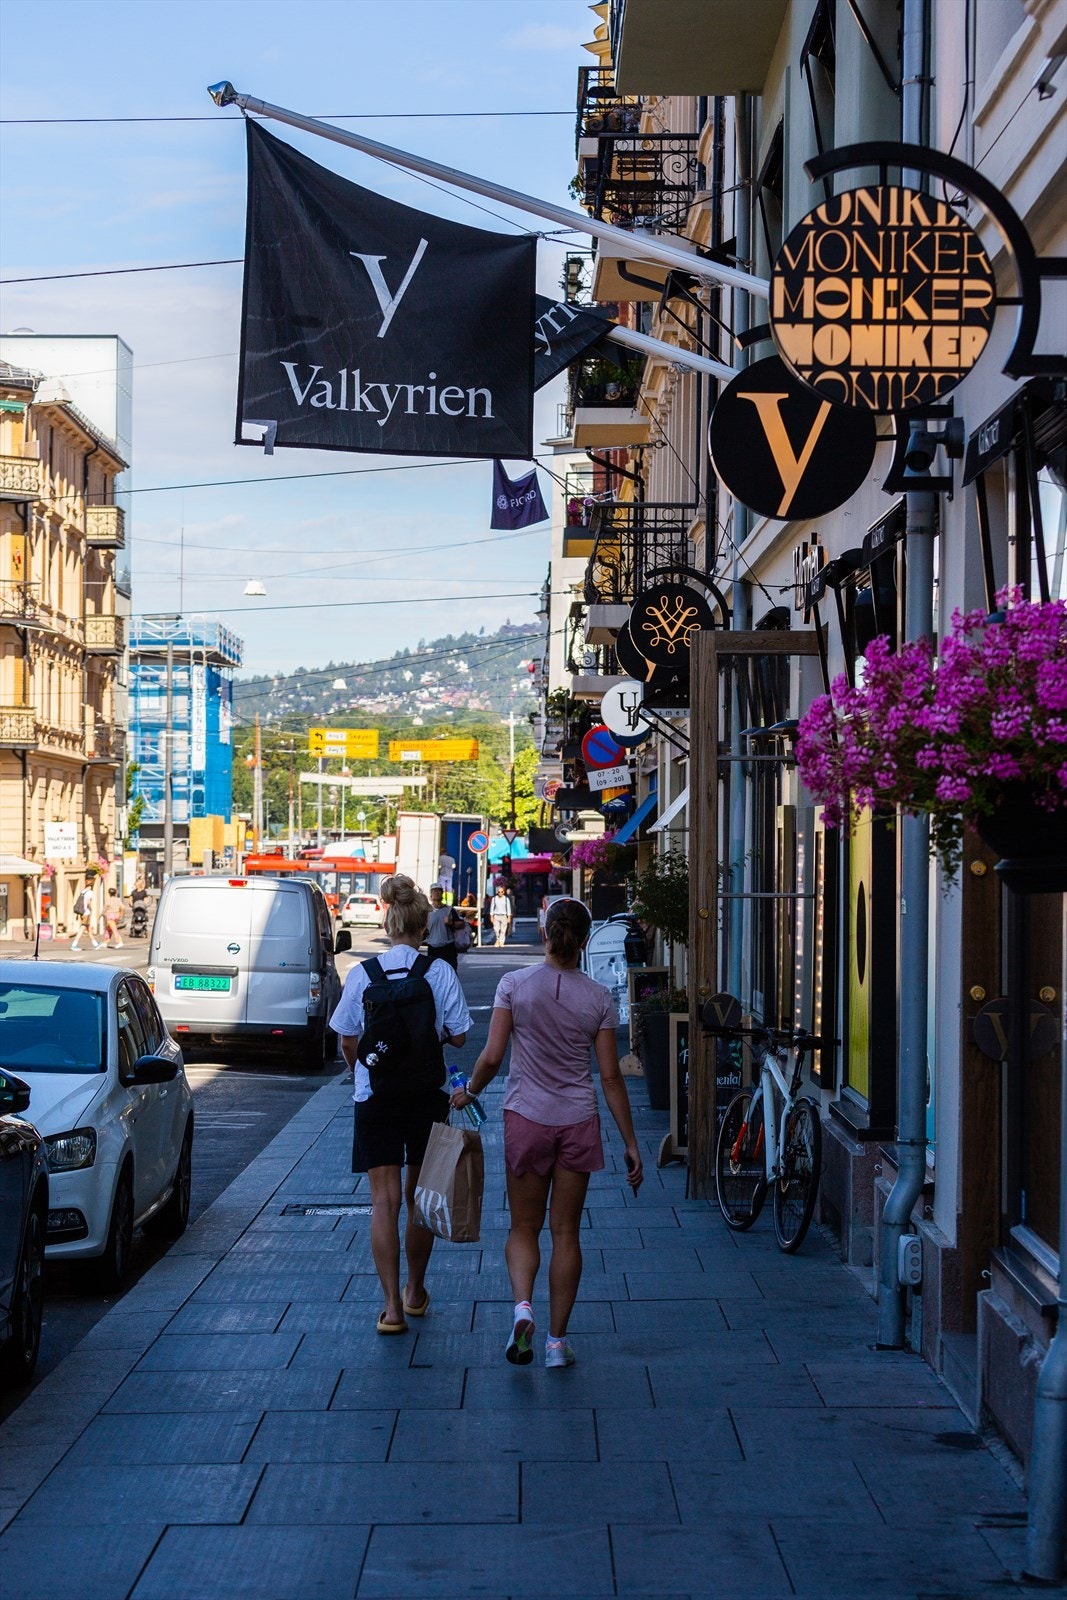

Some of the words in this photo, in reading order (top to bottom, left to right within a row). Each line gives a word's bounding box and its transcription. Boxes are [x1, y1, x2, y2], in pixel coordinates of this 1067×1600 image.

[801, 186, 968, 228] ONIKE
[774, 229, 993, 275] MONIKER
[773, 276, 993, 321] MONIKER
[774, 323, 989, 368] MONIKER
[279, 360, 496, 427] Valkyrien
[801, 370, 967, 411] ONIKE
[596, 779, 607, 787] (09
[183, 977, 195, 987] EB
[198, 977, 228, 988] 88322
[716, 1070, 742, 1087] ental
